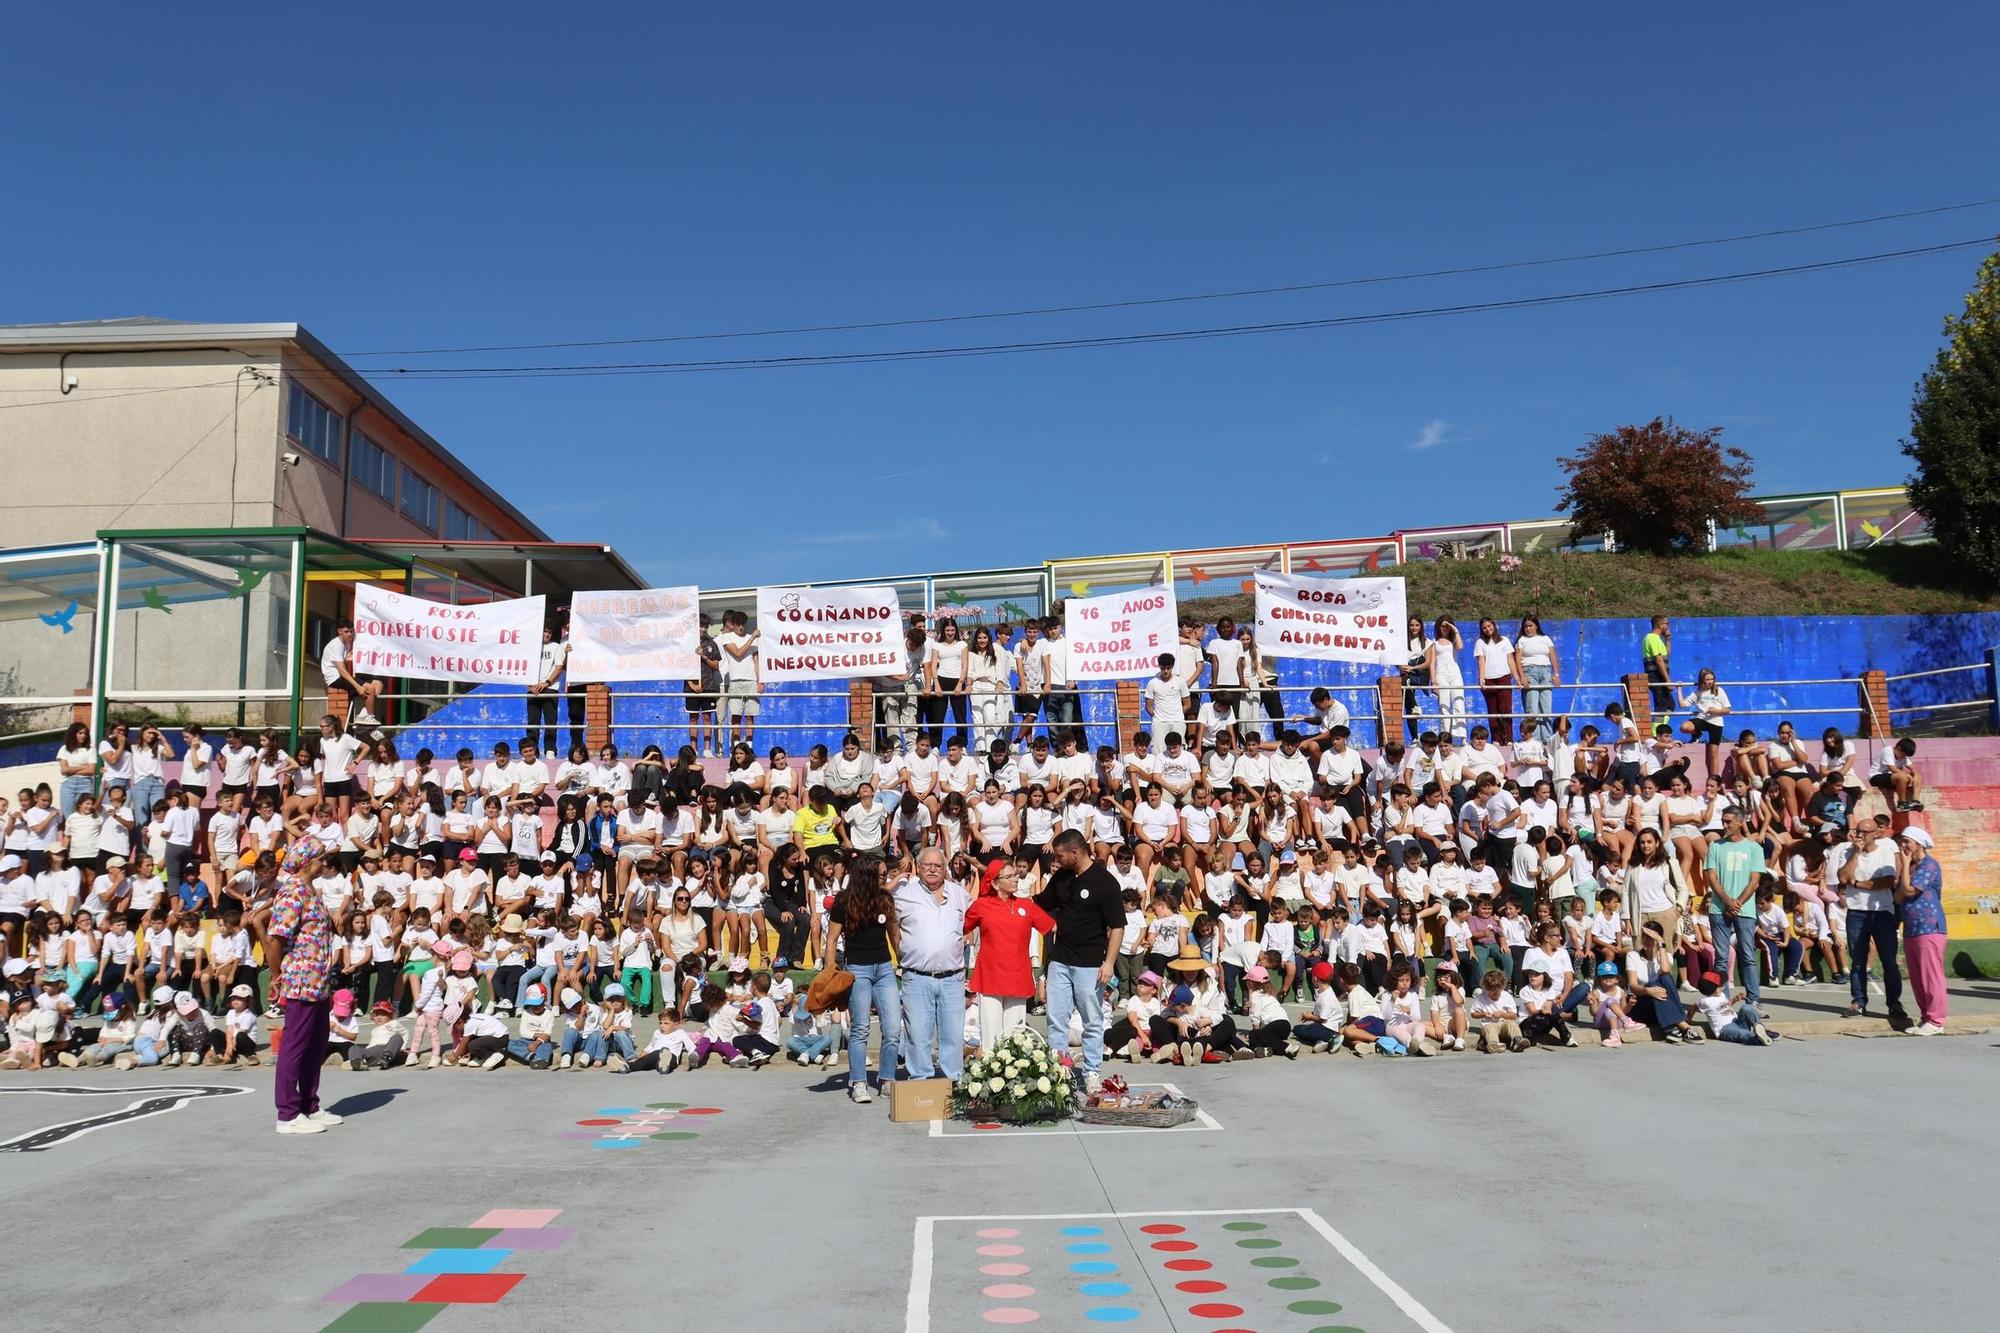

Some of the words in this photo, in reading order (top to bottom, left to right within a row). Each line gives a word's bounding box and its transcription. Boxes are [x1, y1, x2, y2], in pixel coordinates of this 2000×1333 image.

[1122, 596, 1165, 614] ANOS
[1297, 590, 1346, 605] ROSA
[777, 605, 890, 622] COCIÑANDO
[1271, 607, 1338, 625] CHEIRA
[1353, 615, 1389, 628] QUE
[1111, 620, 1131, 633] DE
[499, 629, 521, 644] DE
[780, 632, 883, 646] MOMENTOS
[1073, 639, 1132, 653] SABOR
[1148, 634, 1159, 647] E
[1280, 630, 1385, 650] ALIMENTA
[767, 652, 896, 671] INESQUECIBLES
